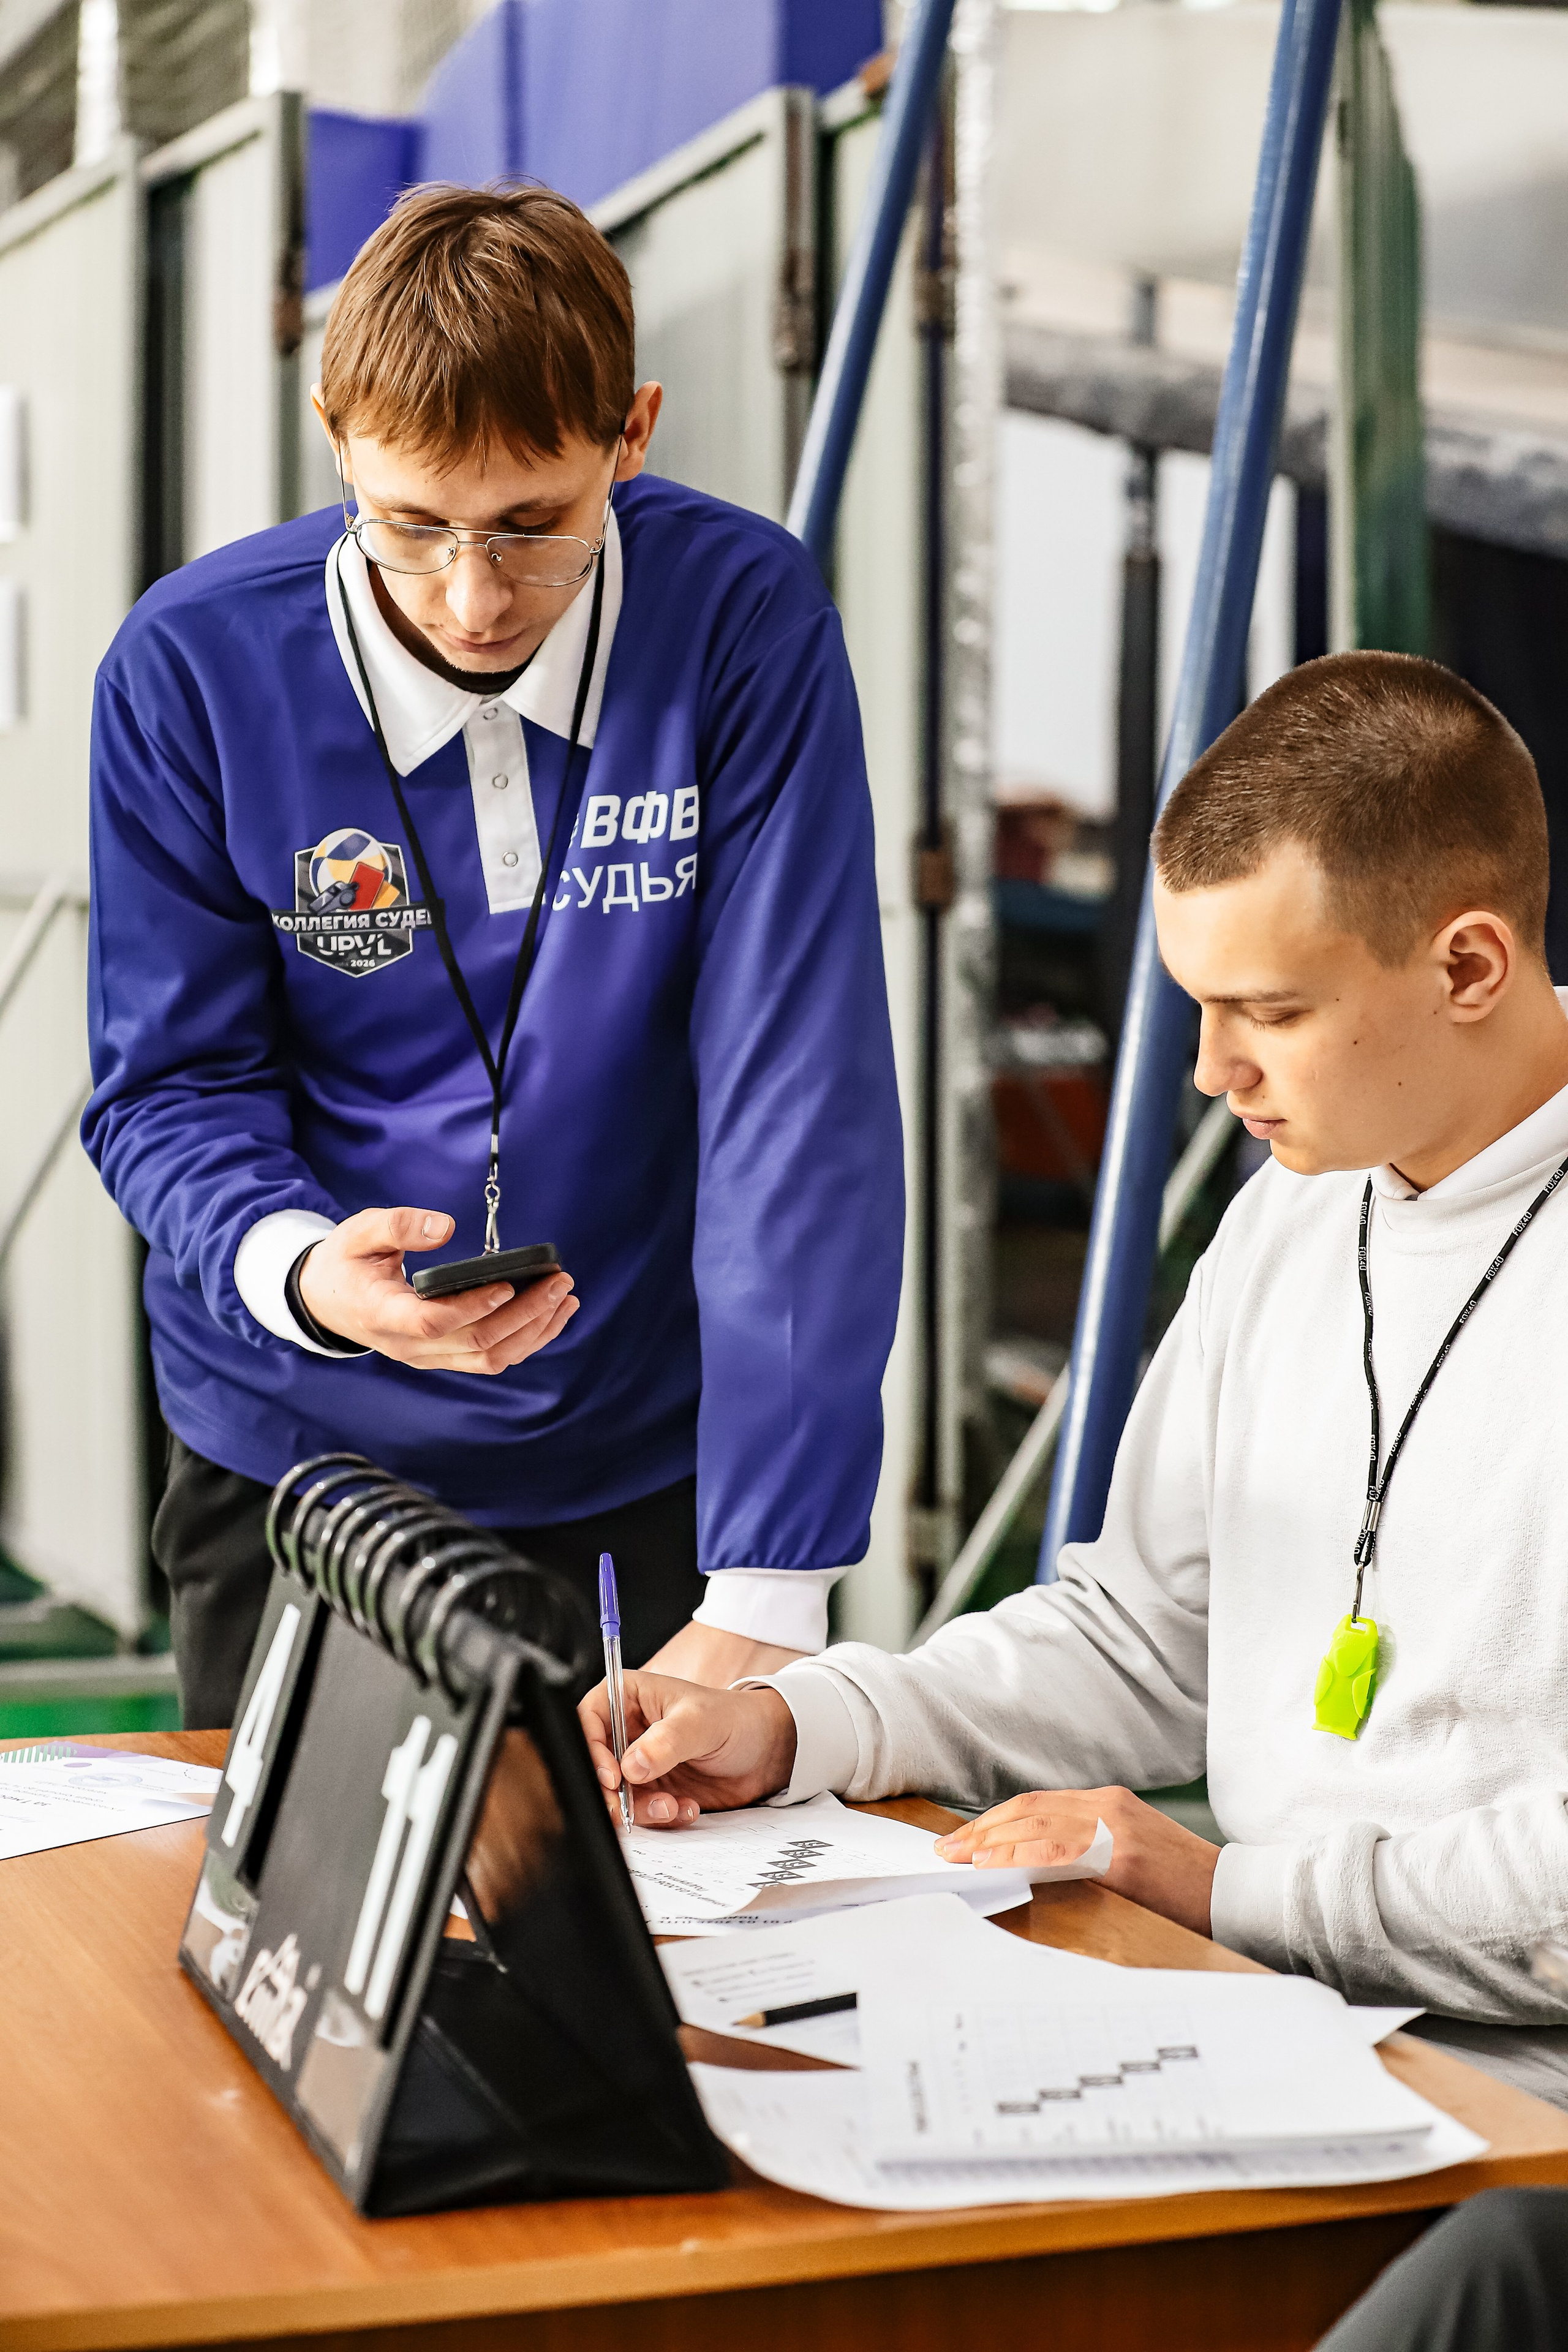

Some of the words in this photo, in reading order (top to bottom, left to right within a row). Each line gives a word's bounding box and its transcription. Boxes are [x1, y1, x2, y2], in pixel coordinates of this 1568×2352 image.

[581, 785, 699, 848] ВФВ
[552, 852, 698, 913] СУДЬЯ
[1543, 1169, 1564, 1193] FOX40
[1512, 1211, 1532, 1237] FOX40
[1485, 1256, 1504, 1281] FOX40
